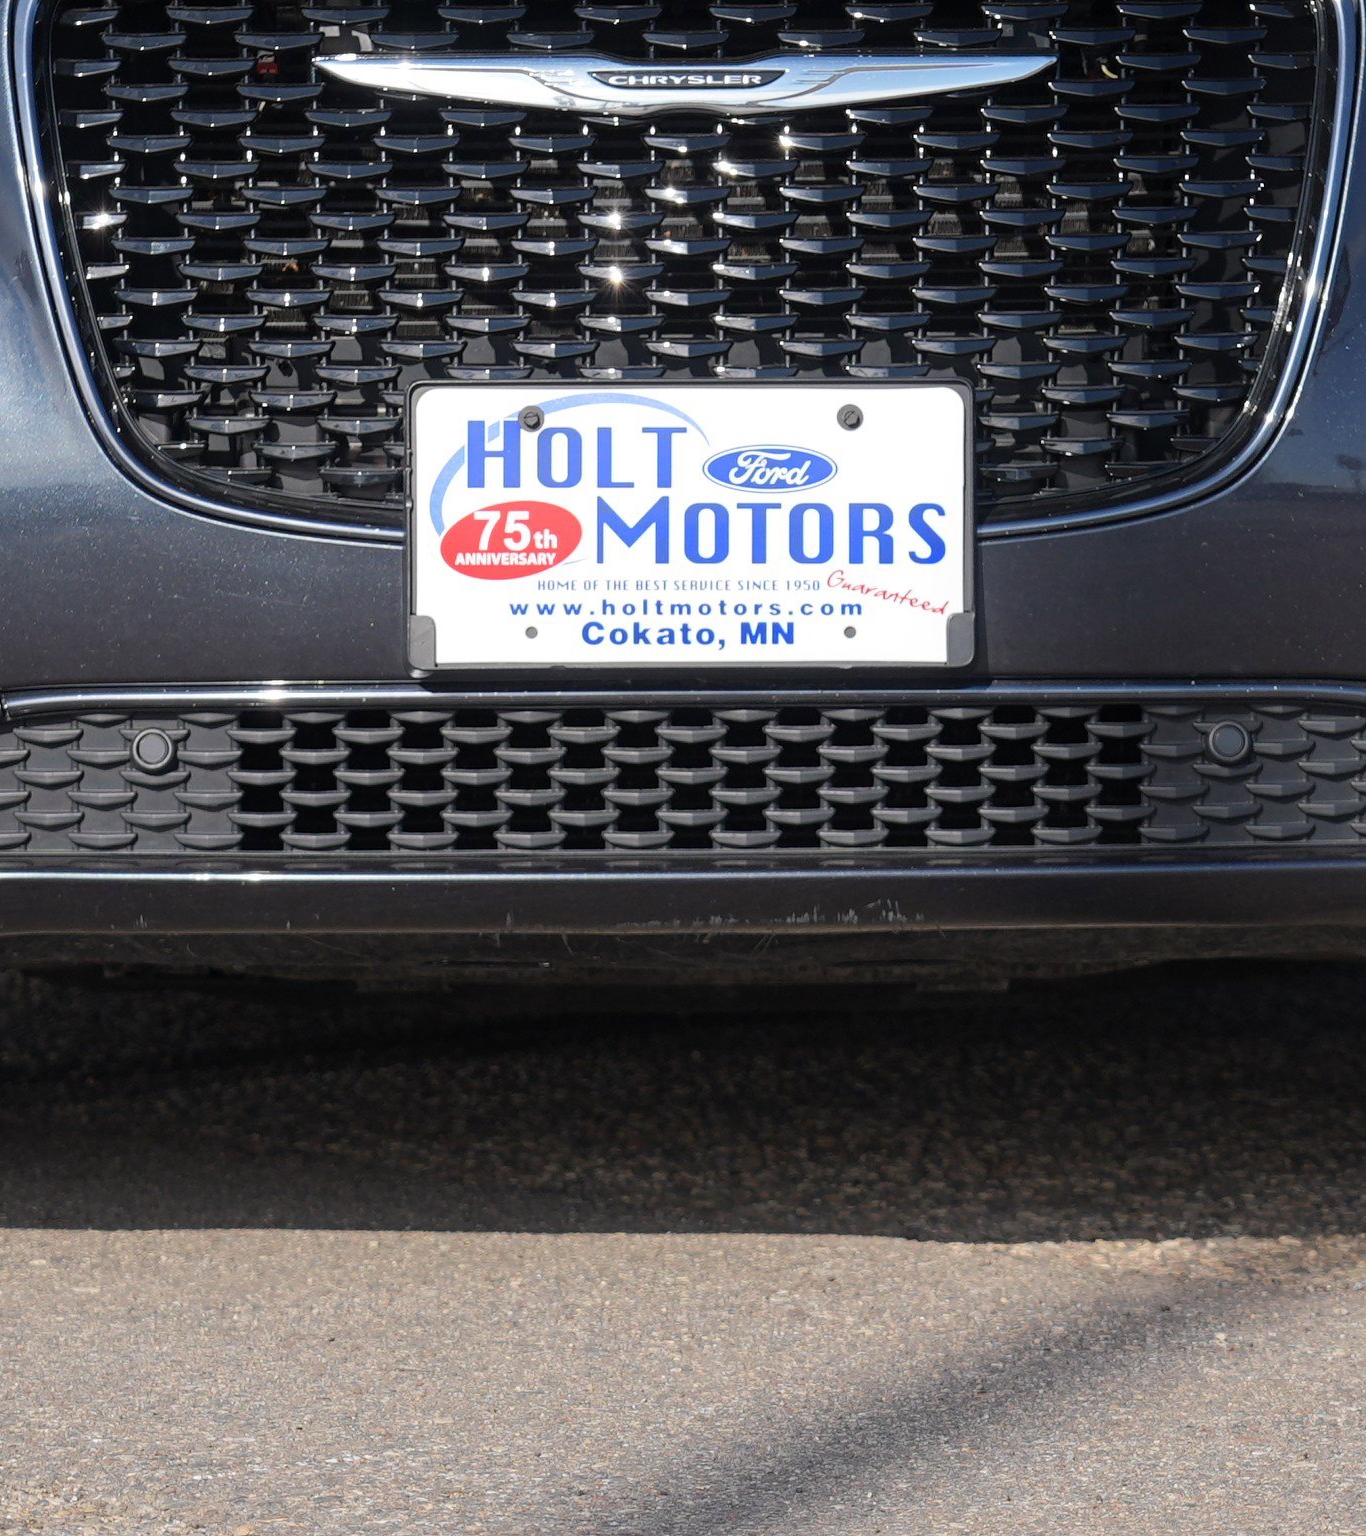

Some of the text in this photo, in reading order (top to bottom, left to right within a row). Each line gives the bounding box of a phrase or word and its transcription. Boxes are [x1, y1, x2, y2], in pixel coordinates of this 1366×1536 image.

[607, 74, 763, 86] CHRYSLER
[466, 419, 688, 489] HOLT
[728, 450, 812, 485] Ford
[473, 510, 558, 551] 75th
[596, 495, 947, 566] MOTORS
[453, 552, 557, 567] ANNIVERSARY
[537, 579, 821, 591] HOME OF THE BEST SERVICE SINCE 1950
[826, 569, 951, 616] Guaranteed
[508, 598, 864, 617] www.holtmotors.com
[580, 620, 796, 650] Cokato, MN
